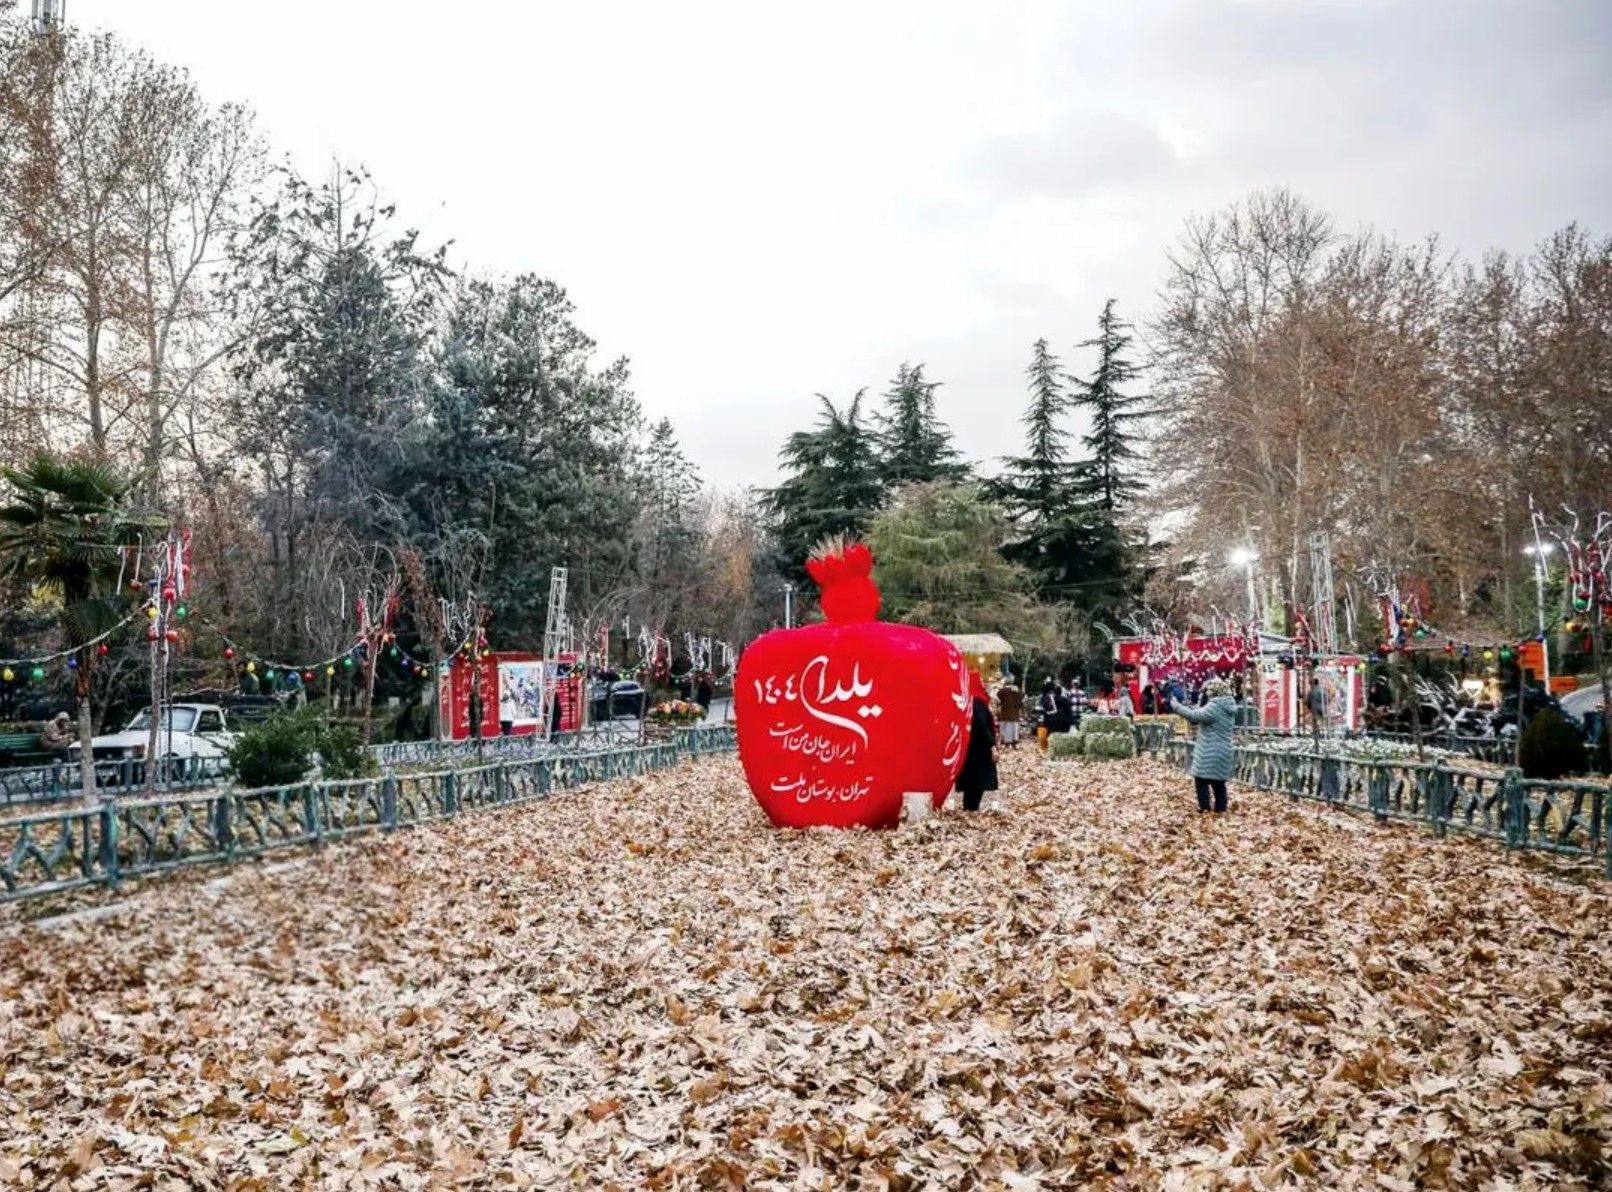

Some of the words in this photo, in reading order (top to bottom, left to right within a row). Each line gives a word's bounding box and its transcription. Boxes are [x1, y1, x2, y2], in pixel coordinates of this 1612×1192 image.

[800, 655, 884, 749] یلدا
[769, 722, 804, 749] است
[788, 733, 810, 751] من
[802, 735, 830, 756] جان
[820, 740, 857, 765] ایران
[770, 772, 807, 792] ملت
[796, 779, 836, 803] بوستان
